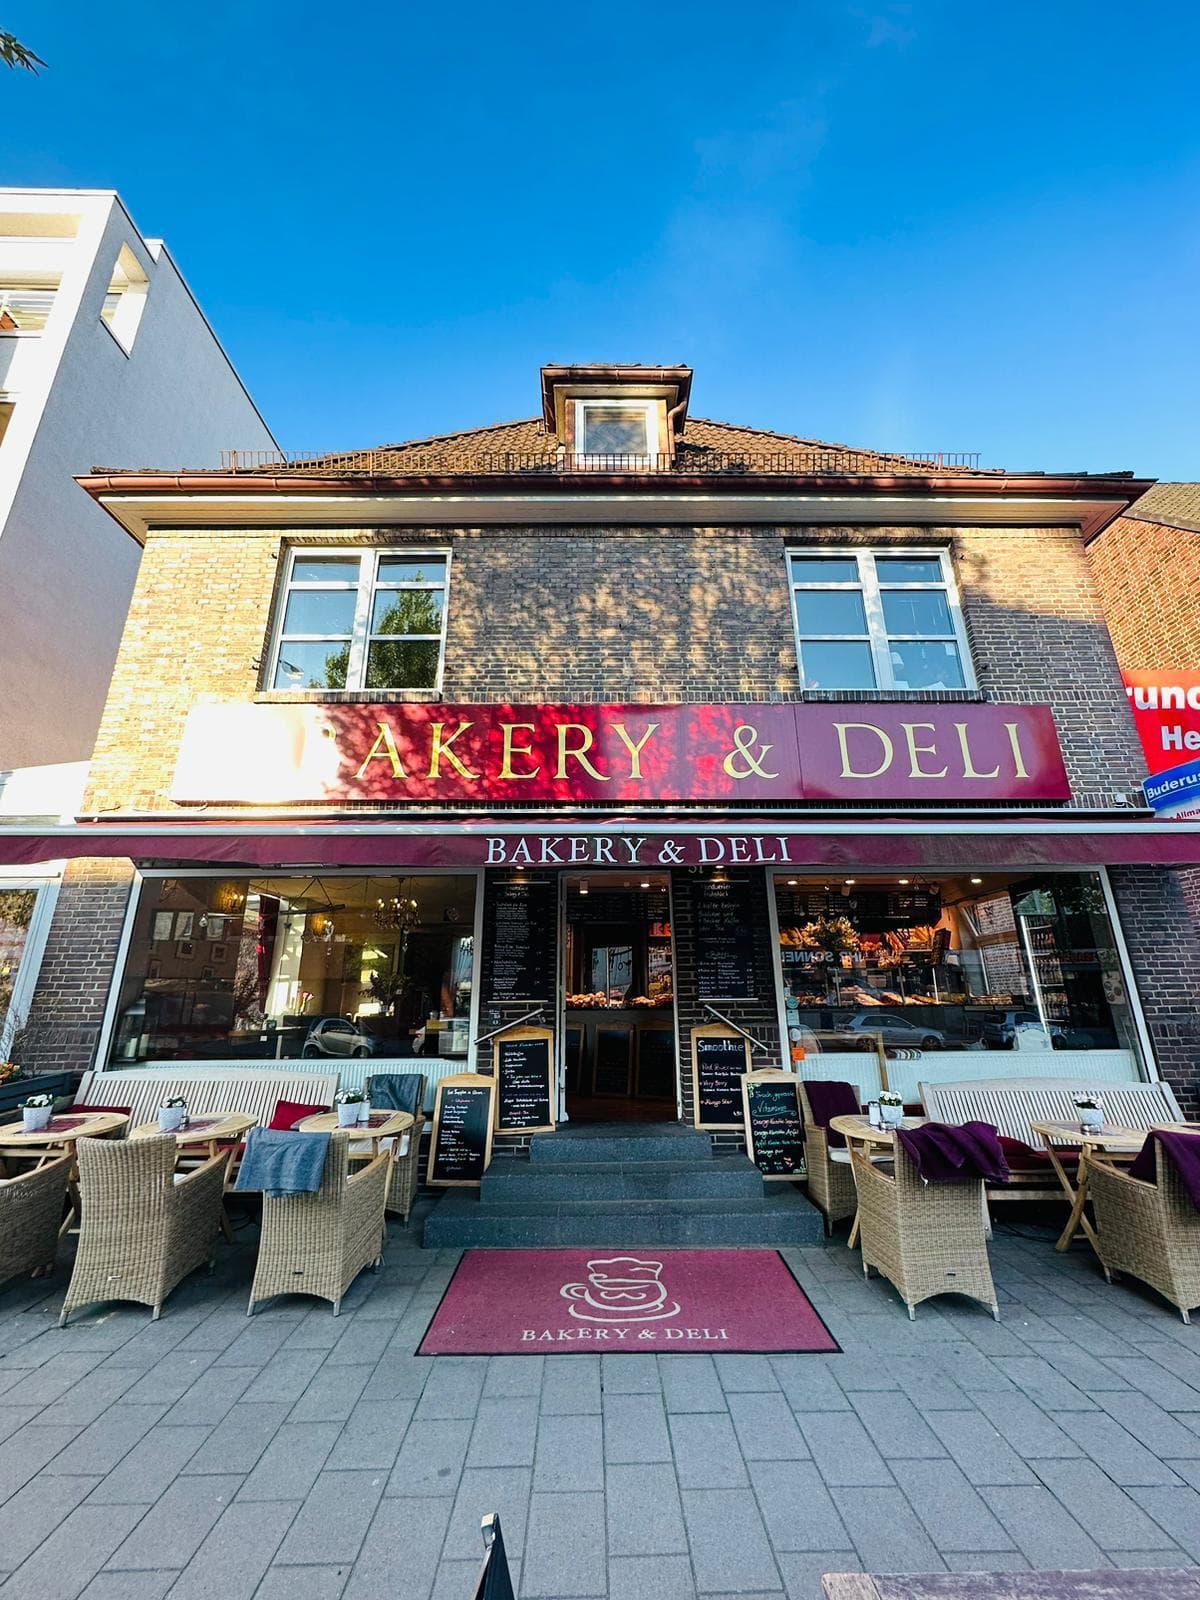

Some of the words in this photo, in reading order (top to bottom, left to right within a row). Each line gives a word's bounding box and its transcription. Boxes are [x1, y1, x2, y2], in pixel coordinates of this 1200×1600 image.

[1126, 686, 1200, 710] un
[312, 721, 661, 781] AKERY
[723, 724, 780, 779] &
[832, 722, 1031, 779] DELI
[1147, 773, 1200, 800] Buderu
[484, 837, 648, 864] BAKERY
[658, 839, 686, 864] &
[698, 836, 793, 863] DELI
[697, 1039, 745, 1052] Smoothie
[521, 1328, 631, 1341] BAKERY
[638, 1328, 657, 1340] &
[664, 1328, 730, 1340] DELI
